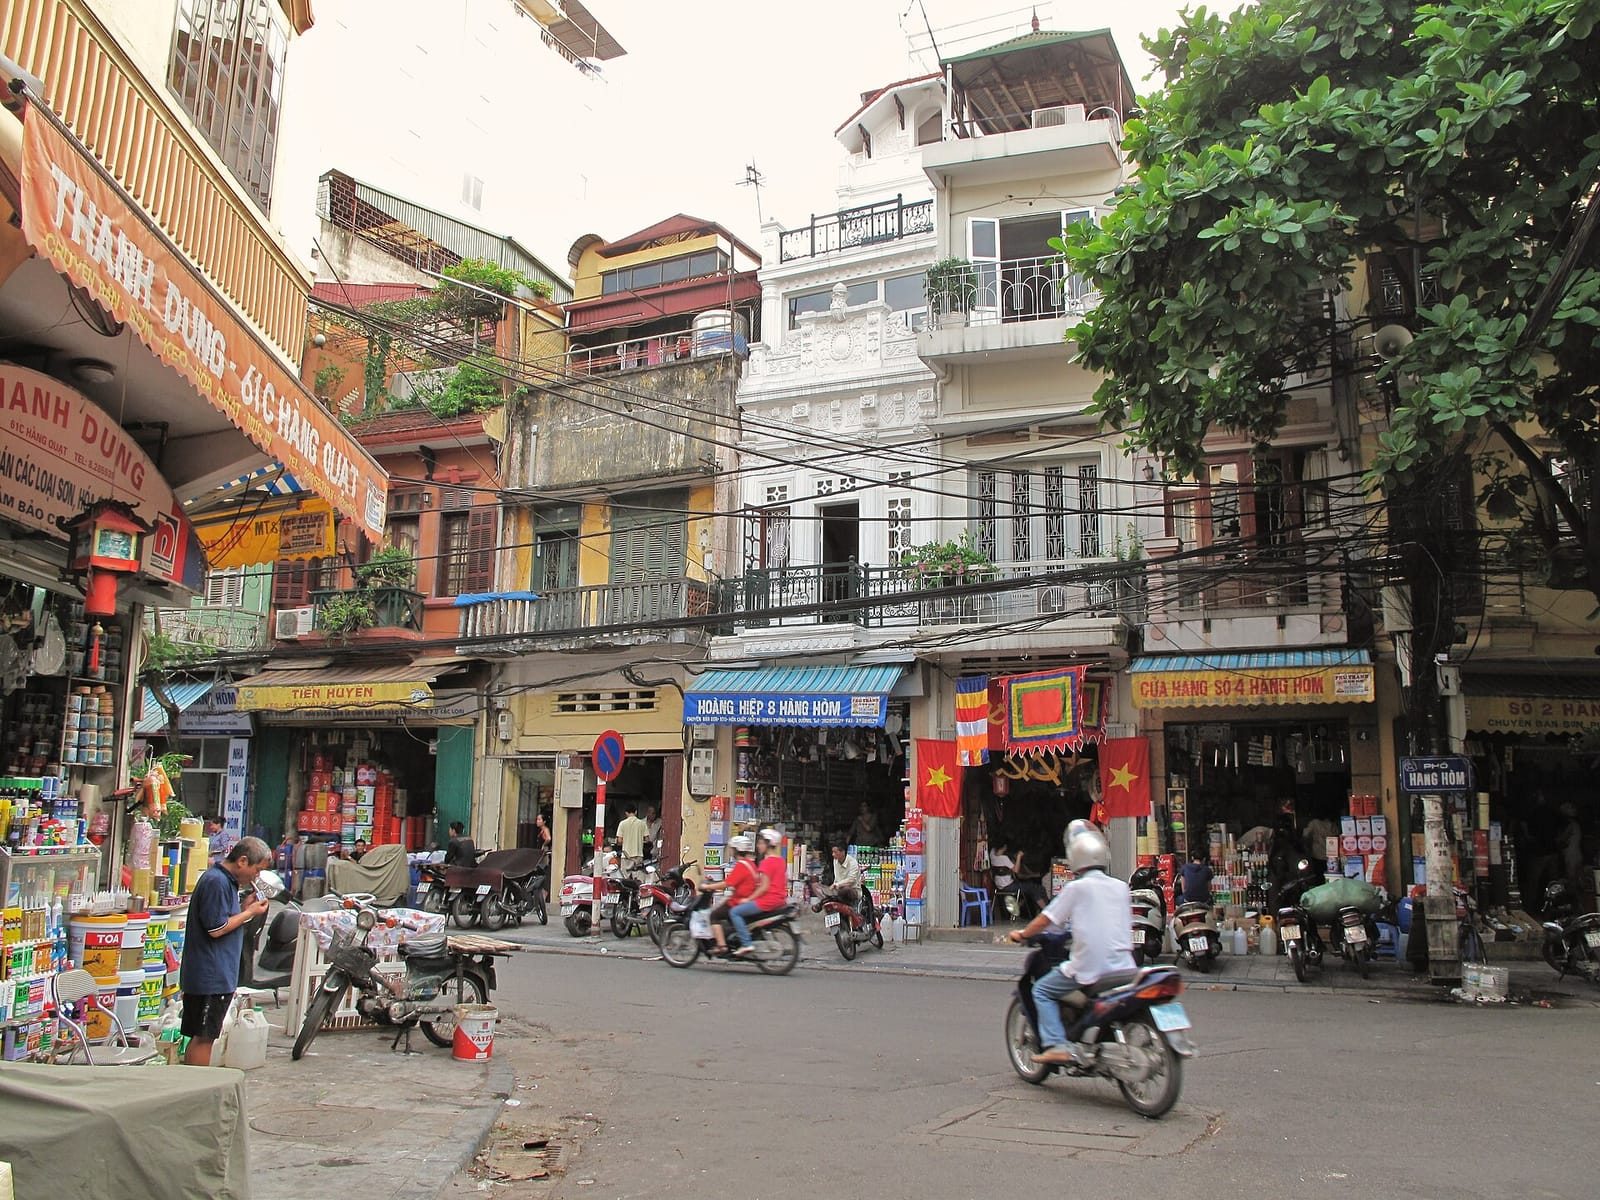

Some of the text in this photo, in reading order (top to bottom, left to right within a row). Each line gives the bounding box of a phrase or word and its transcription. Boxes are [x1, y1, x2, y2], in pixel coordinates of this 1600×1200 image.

[52, 162, 155, 310] THANH
[163, 279, 226, 380] DUNG
[241, 364, 276, 425] 61C
[277, 396, 320, 466] HÀNG
[322, 441, 360, 499] QUẠT
[0, 378, 145, 491] ANH DUNG
[10, 419, 25, 434] 61C
[15, 453, 35, 488] CÁC
[35, 466, 58, 502] LOẠI
[18, 498, 44, 520] BẢO
[1234, 678, 1246, 695] 4
[697, 697, 735, 715] HOÀNG
[740, 697, 764, 718] HIỆP
[767, 700, 776, 715] 8
[780, 697, 809, 716] HÀNG
[813, 697, 841, 716] HÒM
[1542, 703, 1553, 716] 2
[97, 934, 119, 944] TOA
[97, 994, 116, 1005] TOA
